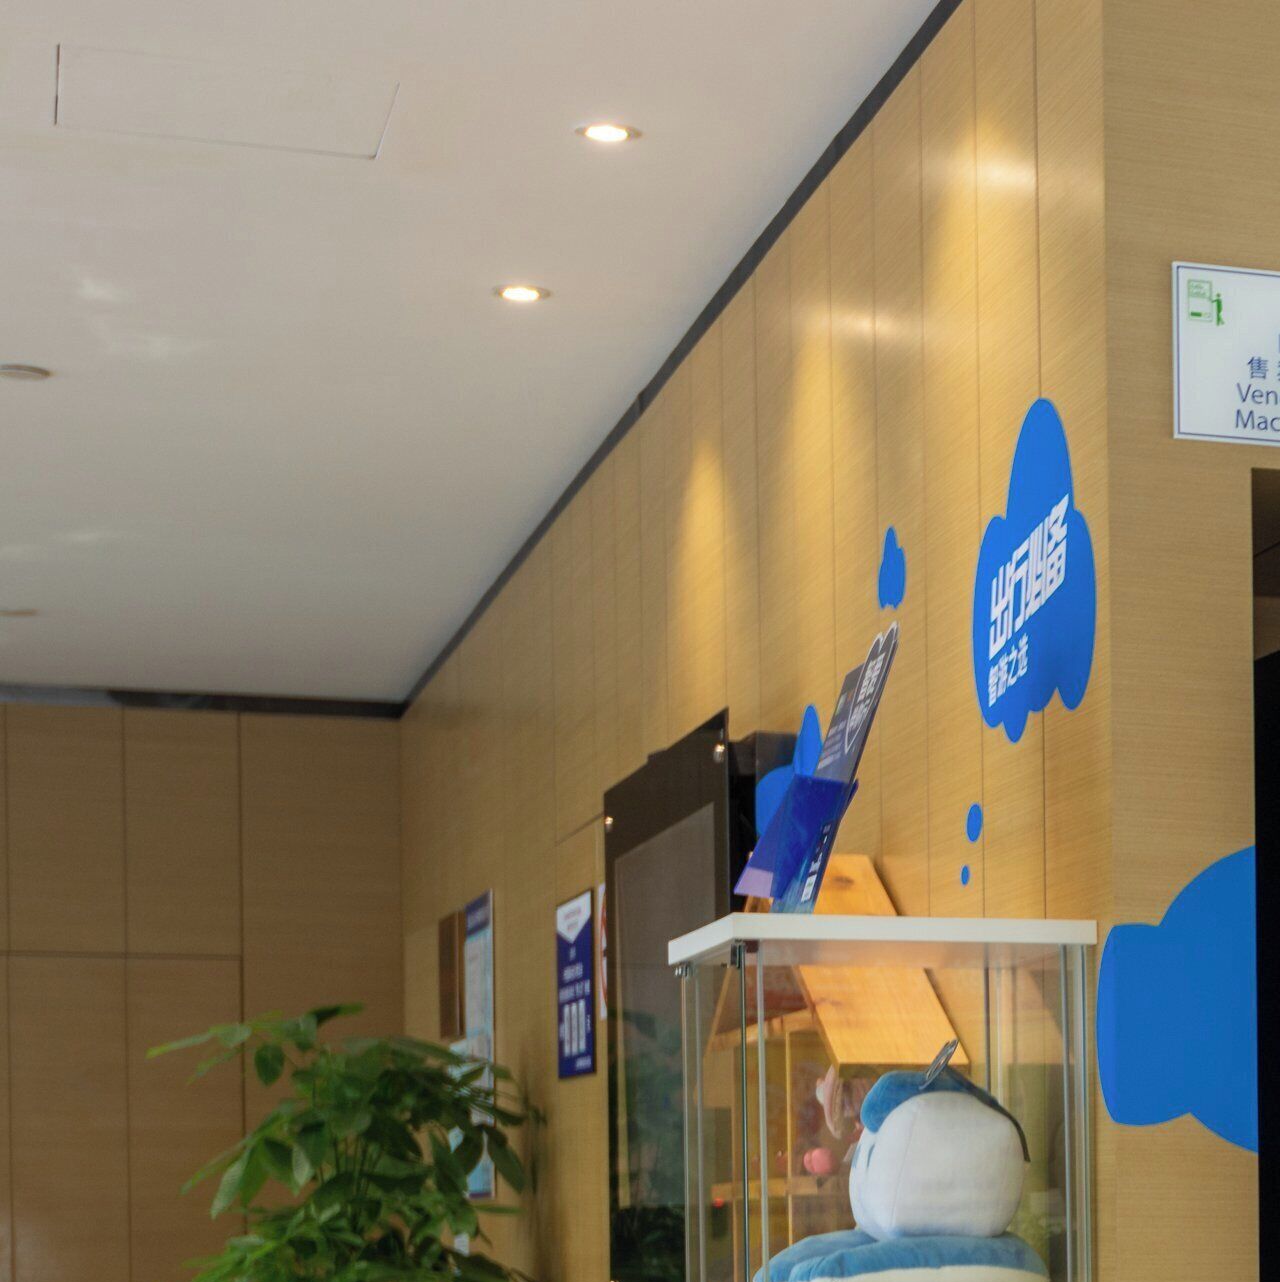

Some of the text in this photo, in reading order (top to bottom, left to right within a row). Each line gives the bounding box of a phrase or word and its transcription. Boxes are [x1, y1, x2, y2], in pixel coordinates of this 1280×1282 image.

[988, 494, 1070, 660] 出行必备
[987, 633, 1029, 708] 智游之选
